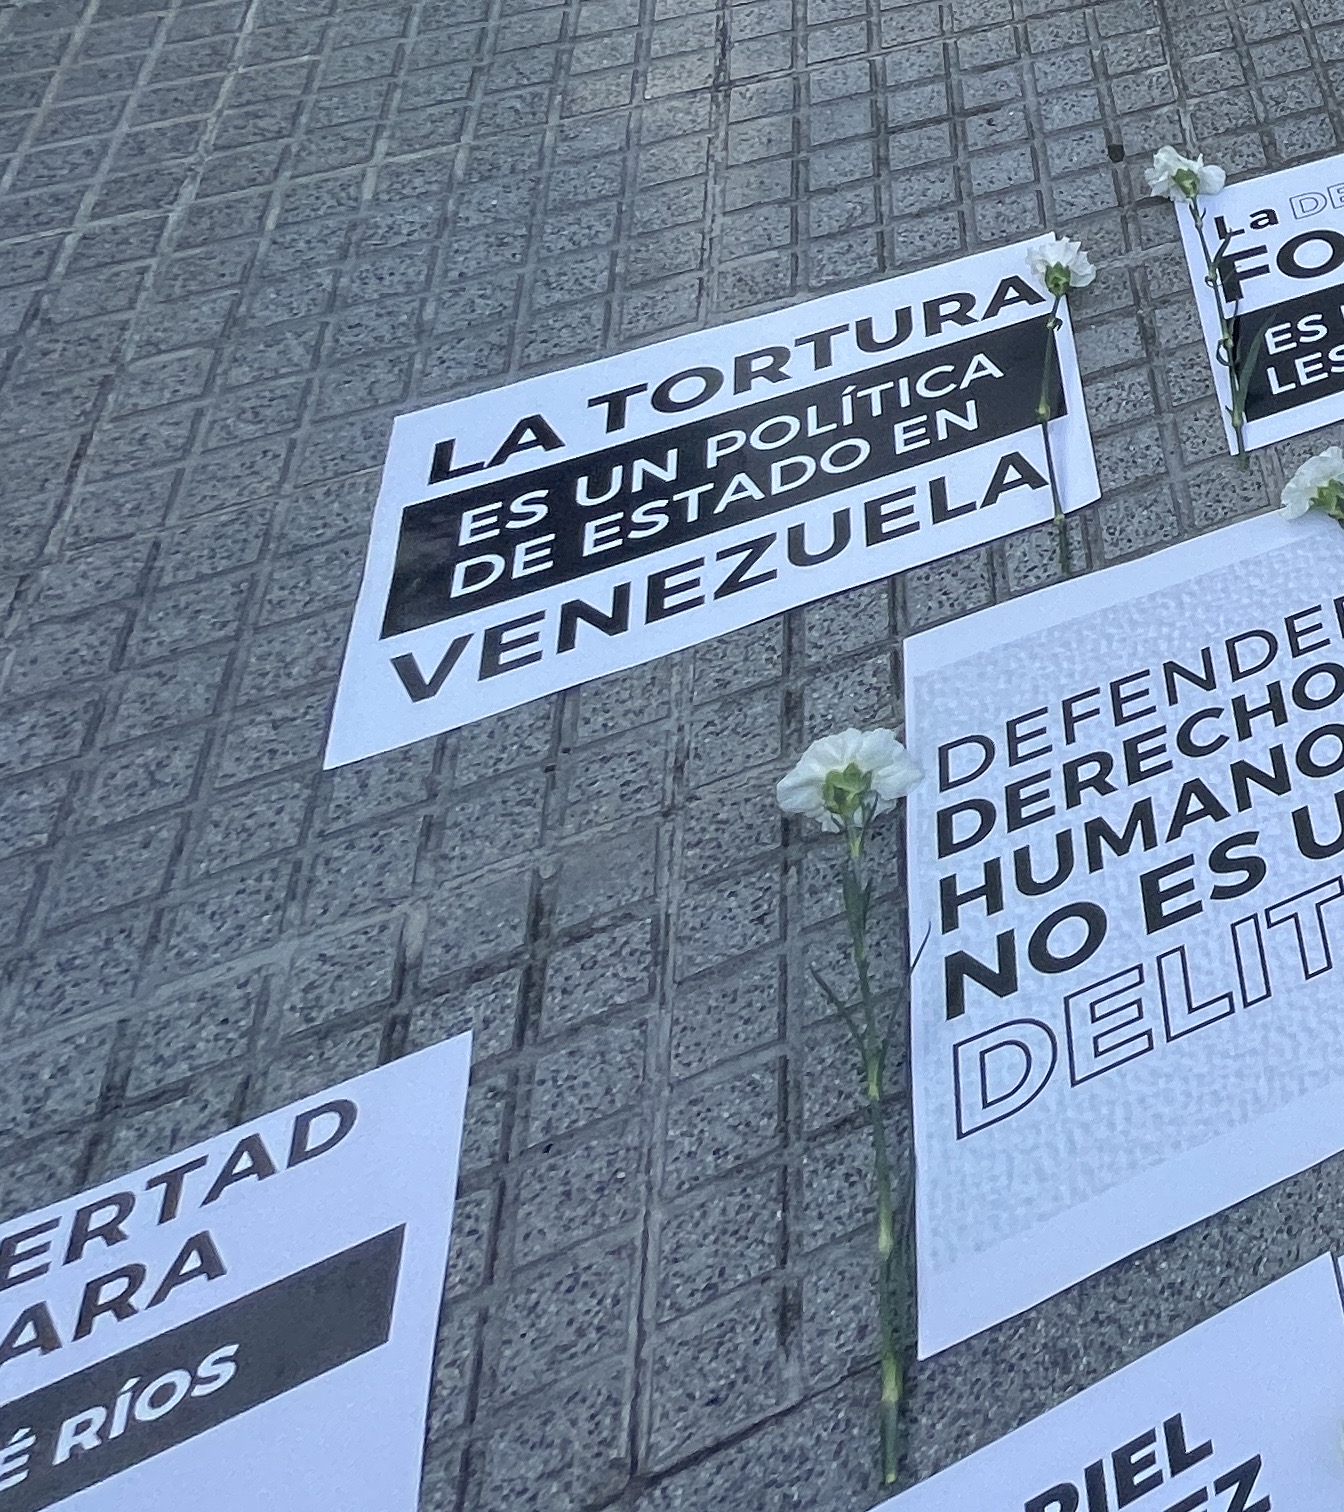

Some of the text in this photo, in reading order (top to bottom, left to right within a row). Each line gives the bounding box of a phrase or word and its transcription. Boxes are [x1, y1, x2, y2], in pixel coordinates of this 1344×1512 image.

[1214, 207, 1280, 238] La
[427, 274, 1048, 486] LA TORTURA
[1263, 318, 1329, 358] ES
[449, 400, 979, 600] DE ESTADO EN
[458, 352, 1005, 548] ES UN POLÍTICA
[391, 450, 1051, 705] VENEZUELA
[944, 900, 1109, 1021] NO
[1141, 829, 1268, 937] ES
[51, 1343, 240, 1467] RÍOS
